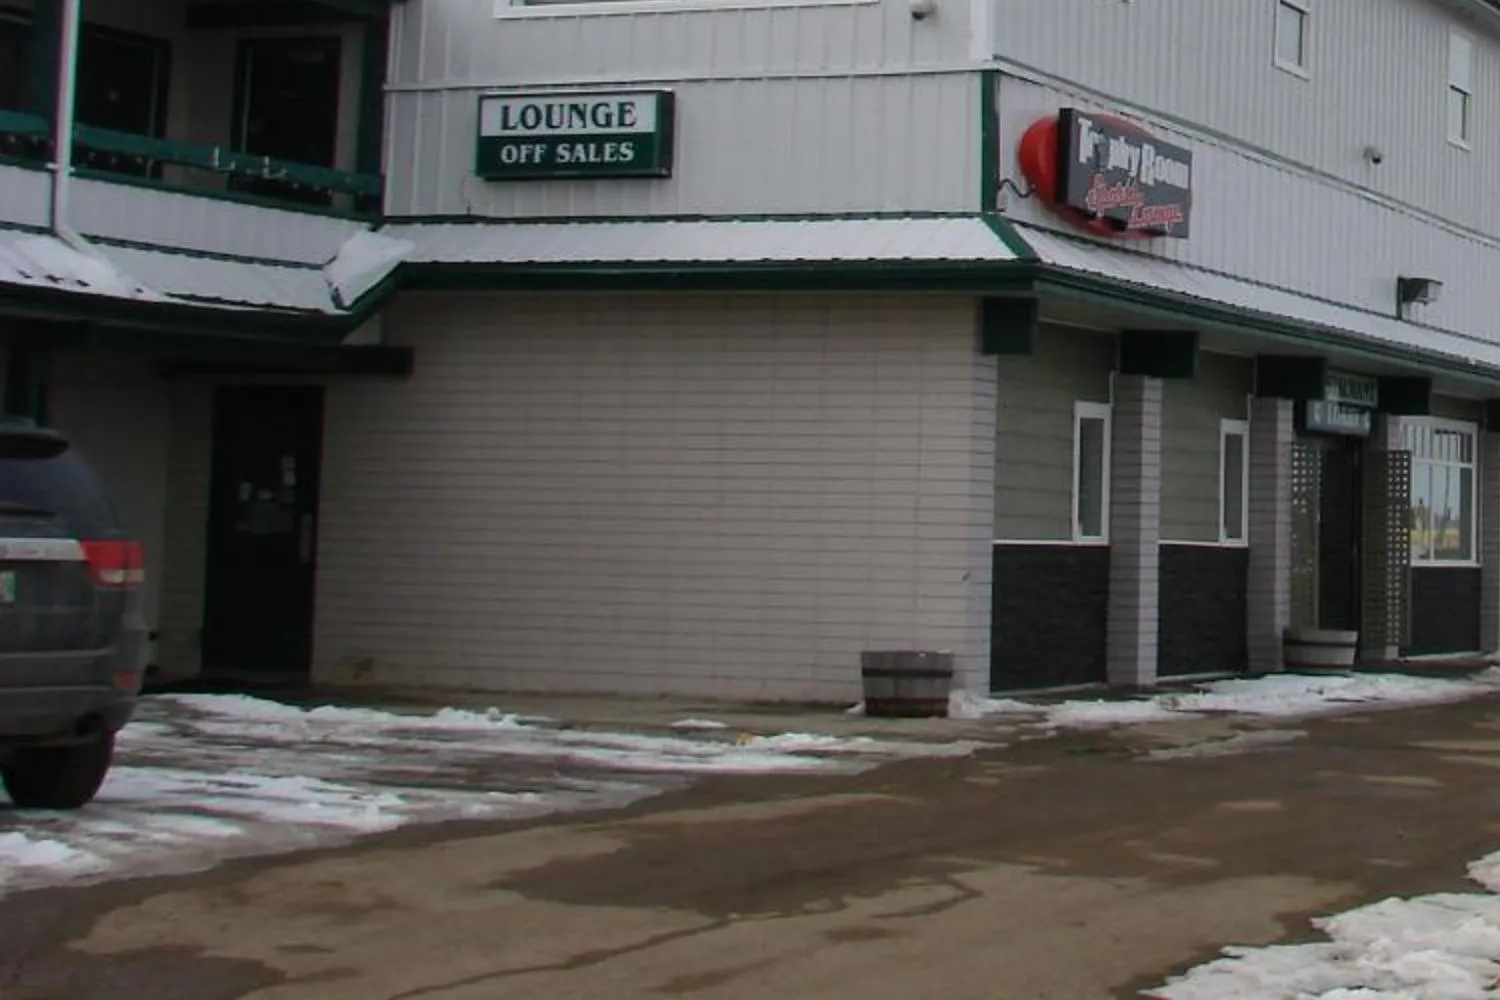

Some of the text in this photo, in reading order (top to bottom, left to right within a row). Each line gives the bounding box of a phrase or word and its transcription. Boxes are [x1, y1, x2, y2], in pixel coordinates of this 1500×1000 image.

[501, 102, 638, 131] LOUNGE
[501, 142, 635, 164] OFF SALES
[1140, 143, 1190, 190] Room
